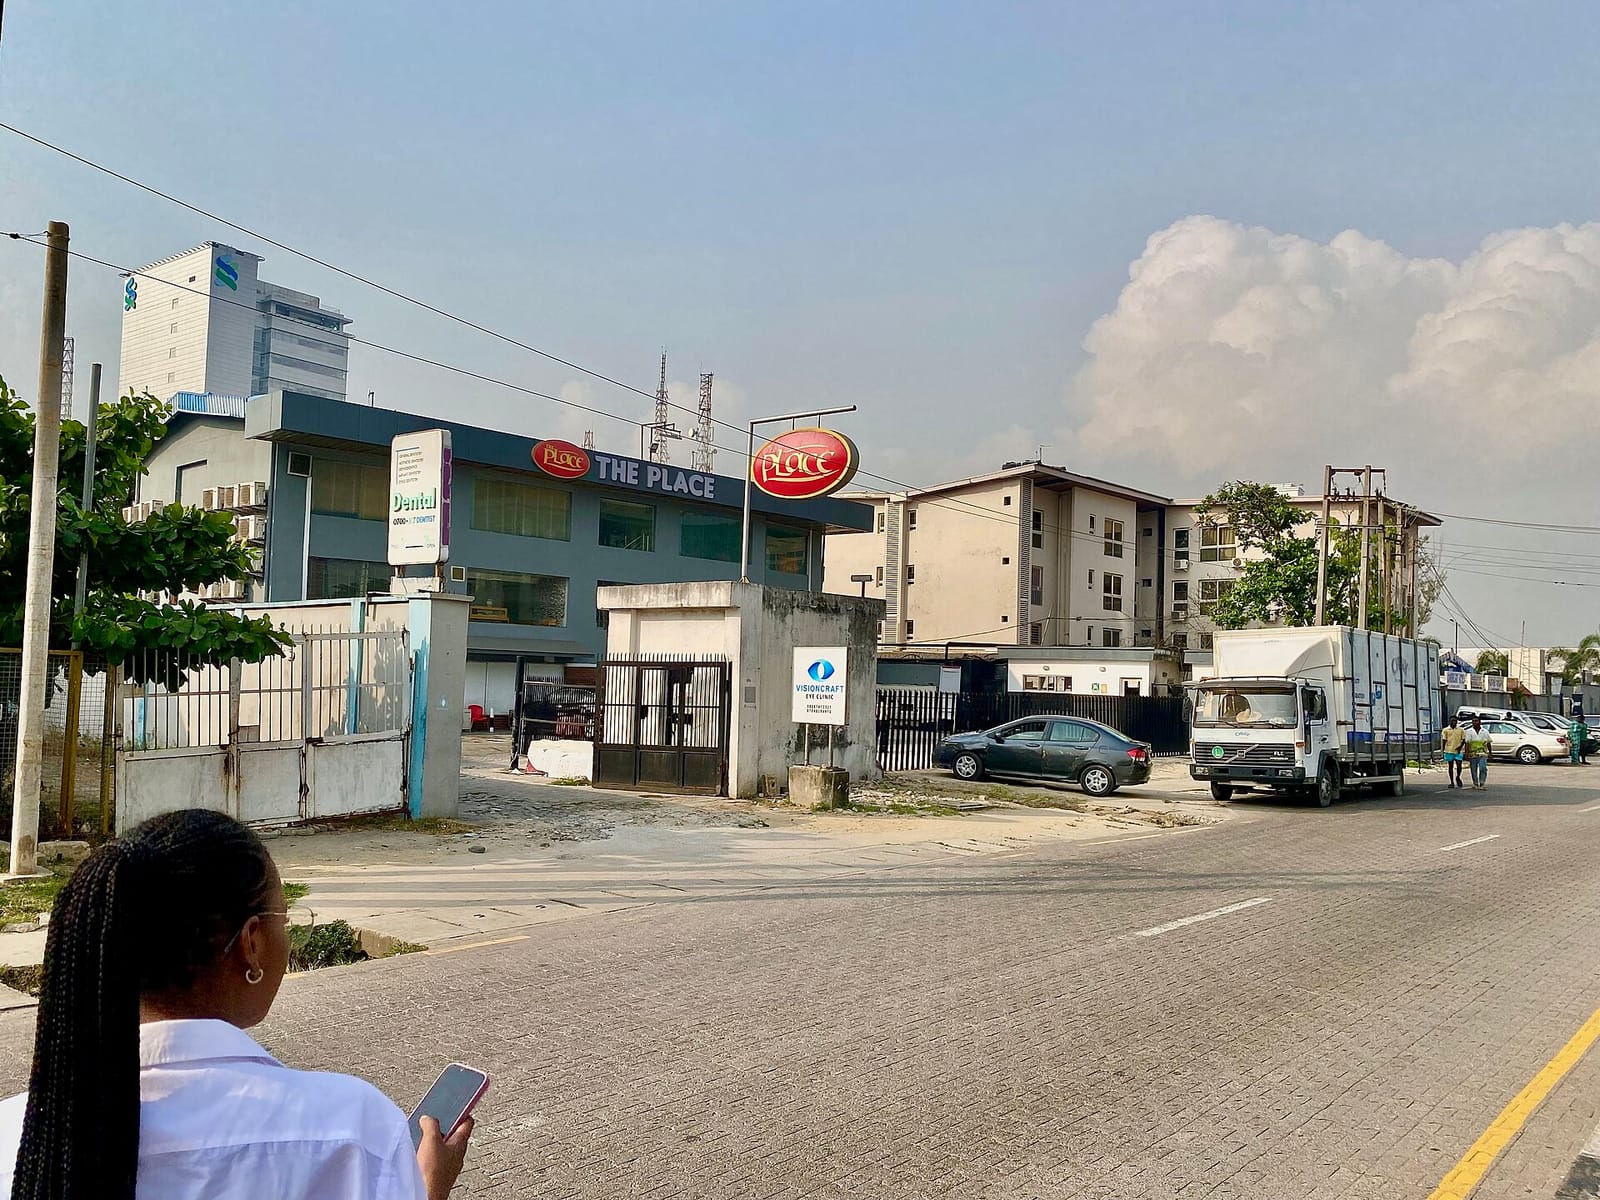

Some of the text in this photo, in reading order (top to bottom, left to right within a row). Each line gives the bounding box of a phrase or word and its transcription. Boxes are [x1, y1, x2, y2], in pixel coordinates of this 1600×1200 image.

[594, 455, 715, 499] THE PLACE
[392, 488, 437, 512] Dental
[796, 684, 844, 692] VISIONCRAFT
